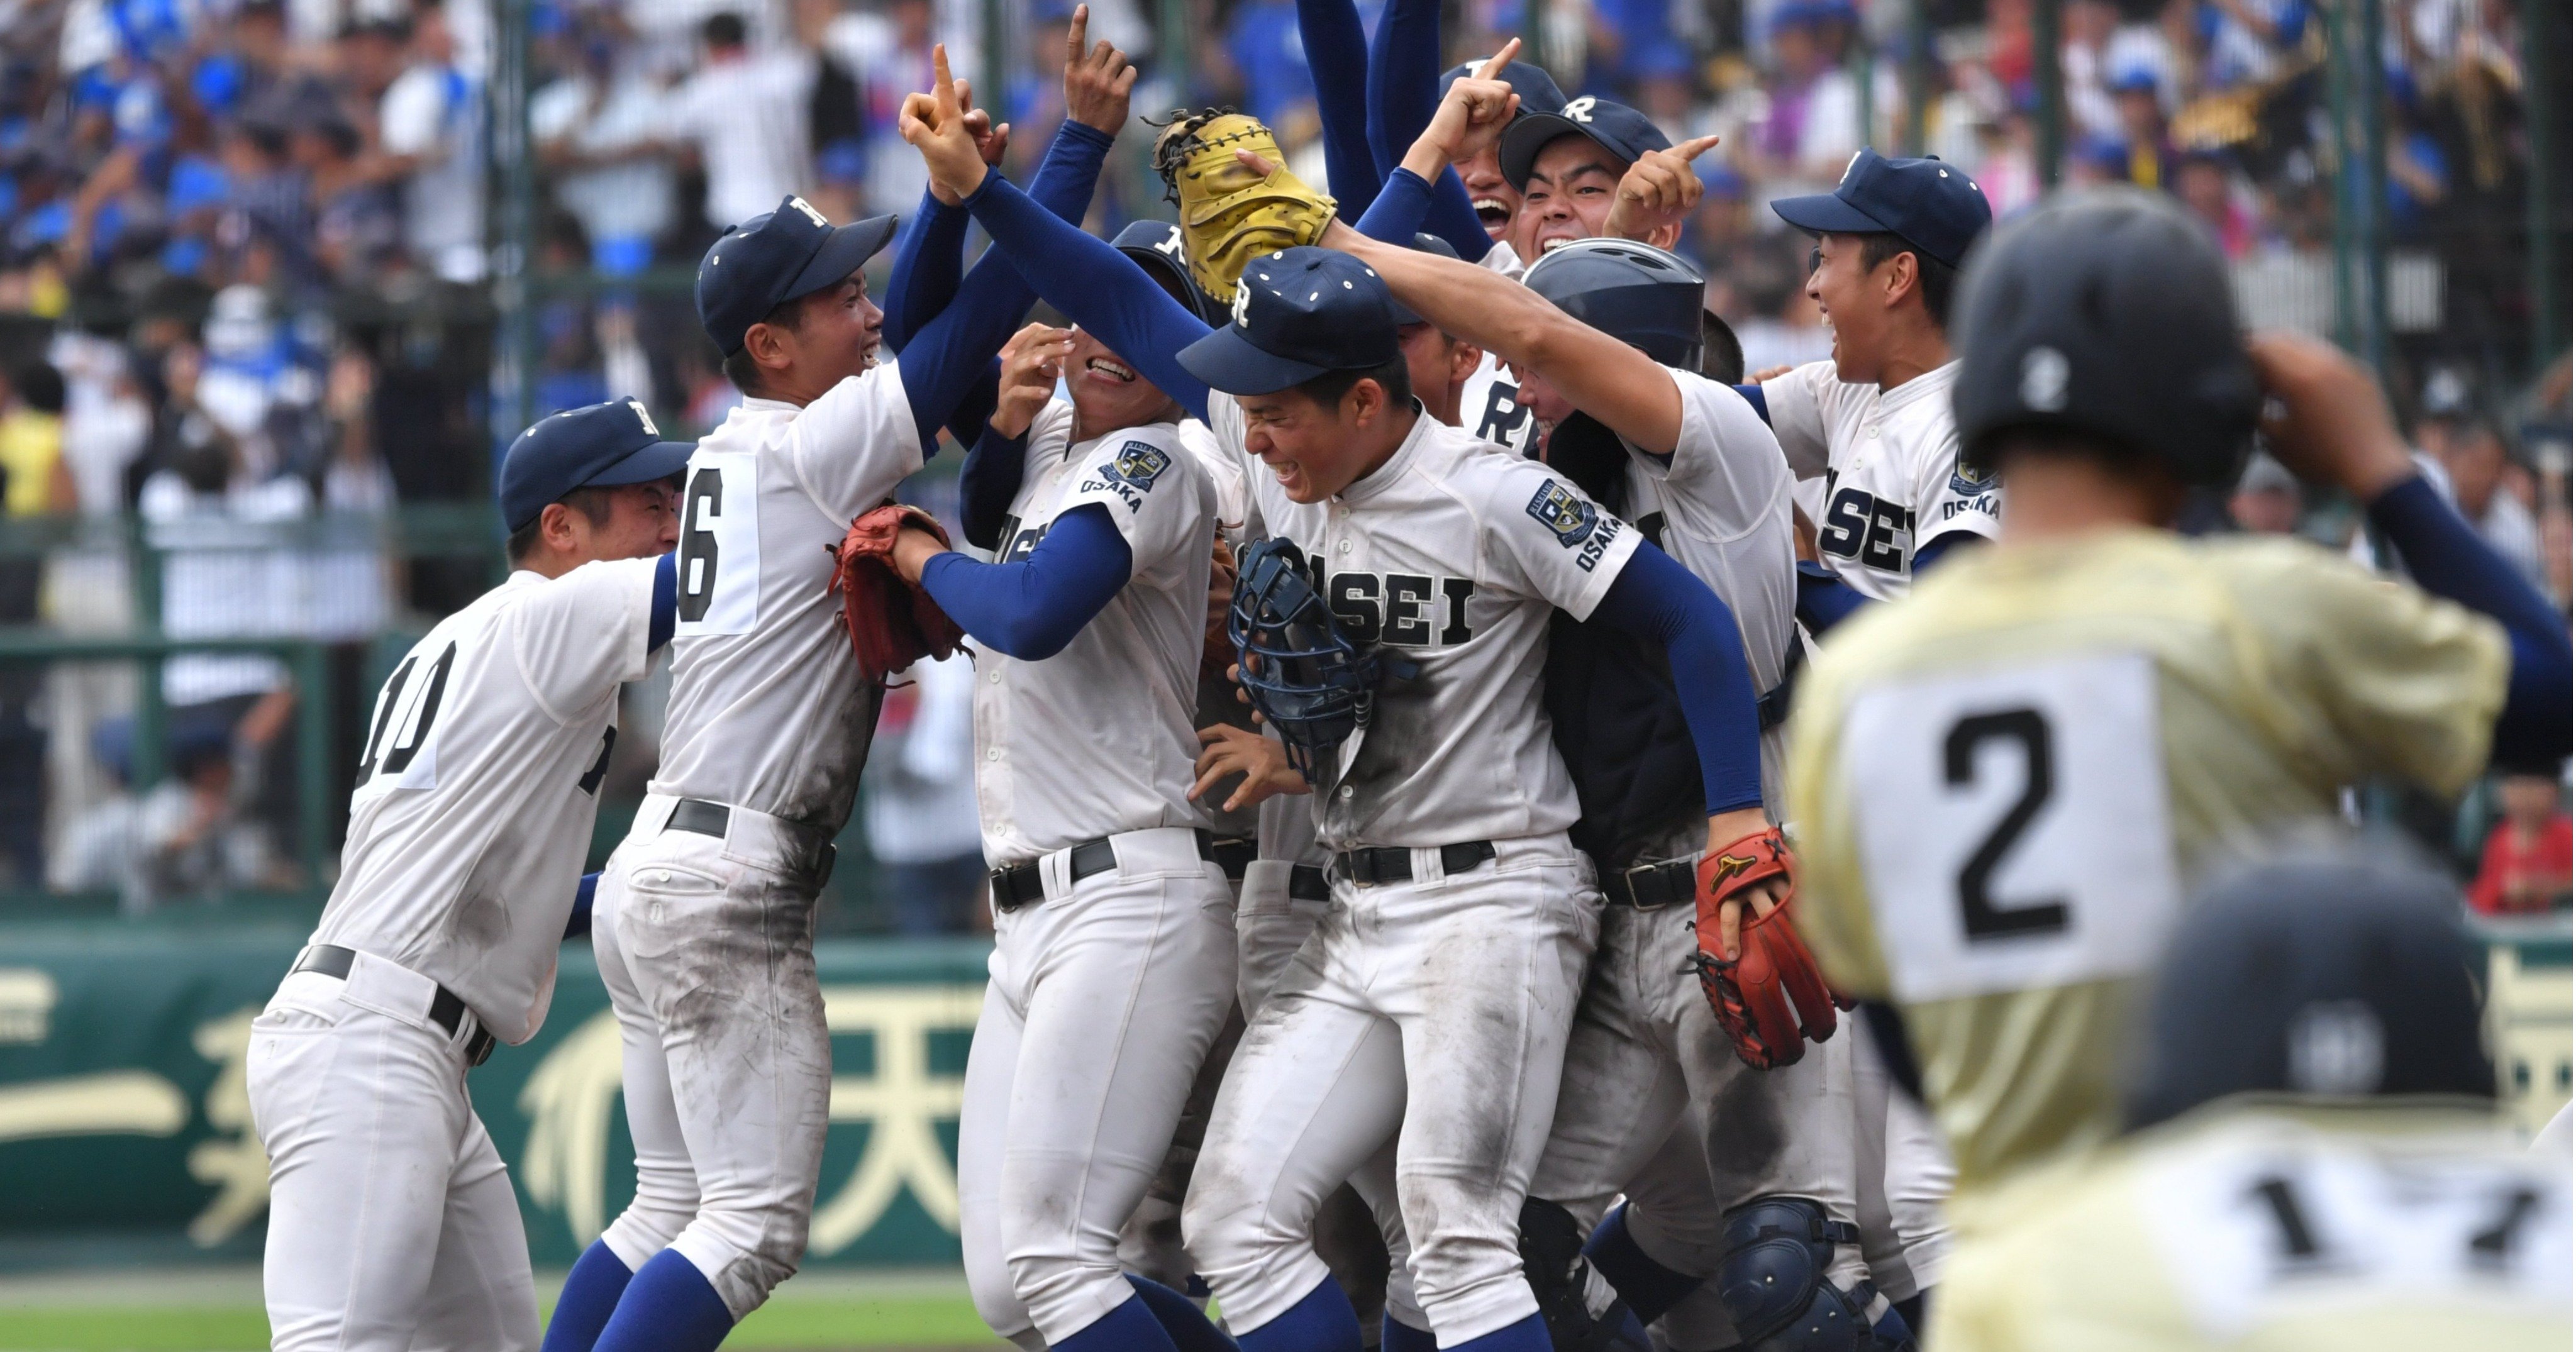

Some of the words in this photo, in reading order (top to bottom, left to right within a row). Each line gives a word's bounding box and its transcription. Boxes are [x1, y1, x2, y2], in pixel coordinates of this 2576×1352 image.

[1565, 97, 1597, 123] R
[1231, 277, 1251, 328] R
[1080, 480, 1142, 515] OSAKA
[679, 468, 723, 623] 6
[1576, 518, 1622, 573] OSAKA
[355, 639, 457, 790] 10
[1941, 704, 2073, 943] 2
